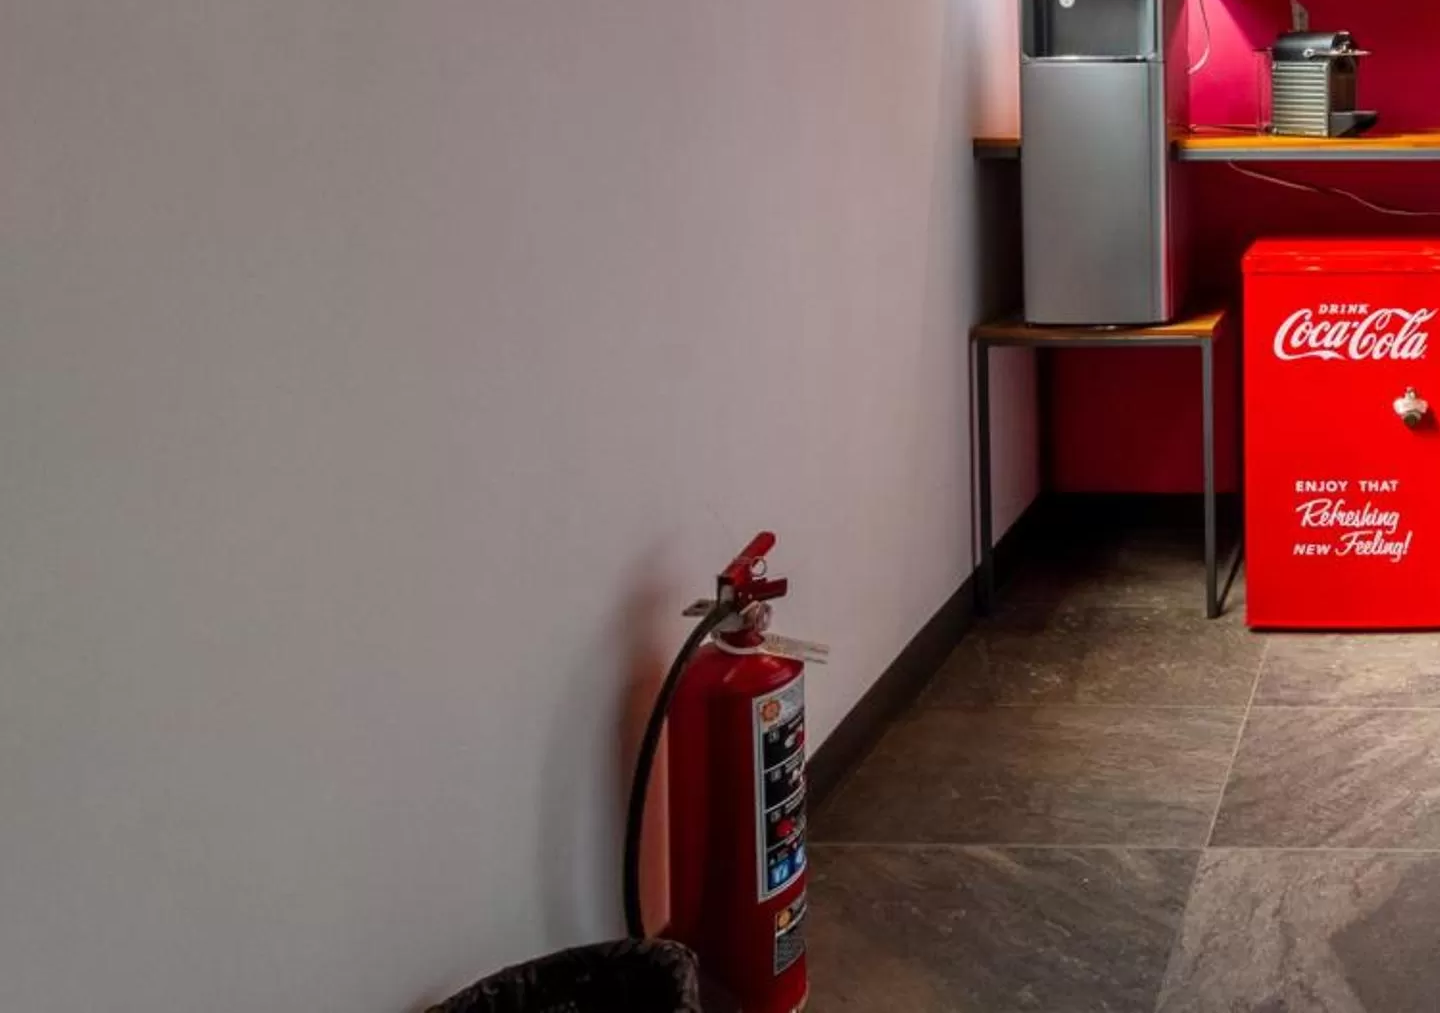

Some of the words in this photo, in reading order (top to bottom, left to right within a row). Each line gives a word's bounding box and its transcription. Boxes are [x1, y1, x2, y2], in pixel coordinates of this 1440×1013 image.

[1318, 303, 1369, 315] DRINK
[1273, 307, 1440, 361] Coca-Cola
[1295, 480, 1348, 493] ENJOY
[1358, 479, 1400, 492] THAT
[1295, 498, 1400, 535] Refreshing
[1293, 543, 1331, 556] NEW
[1334, 529, 1413, 563] Feeling!
